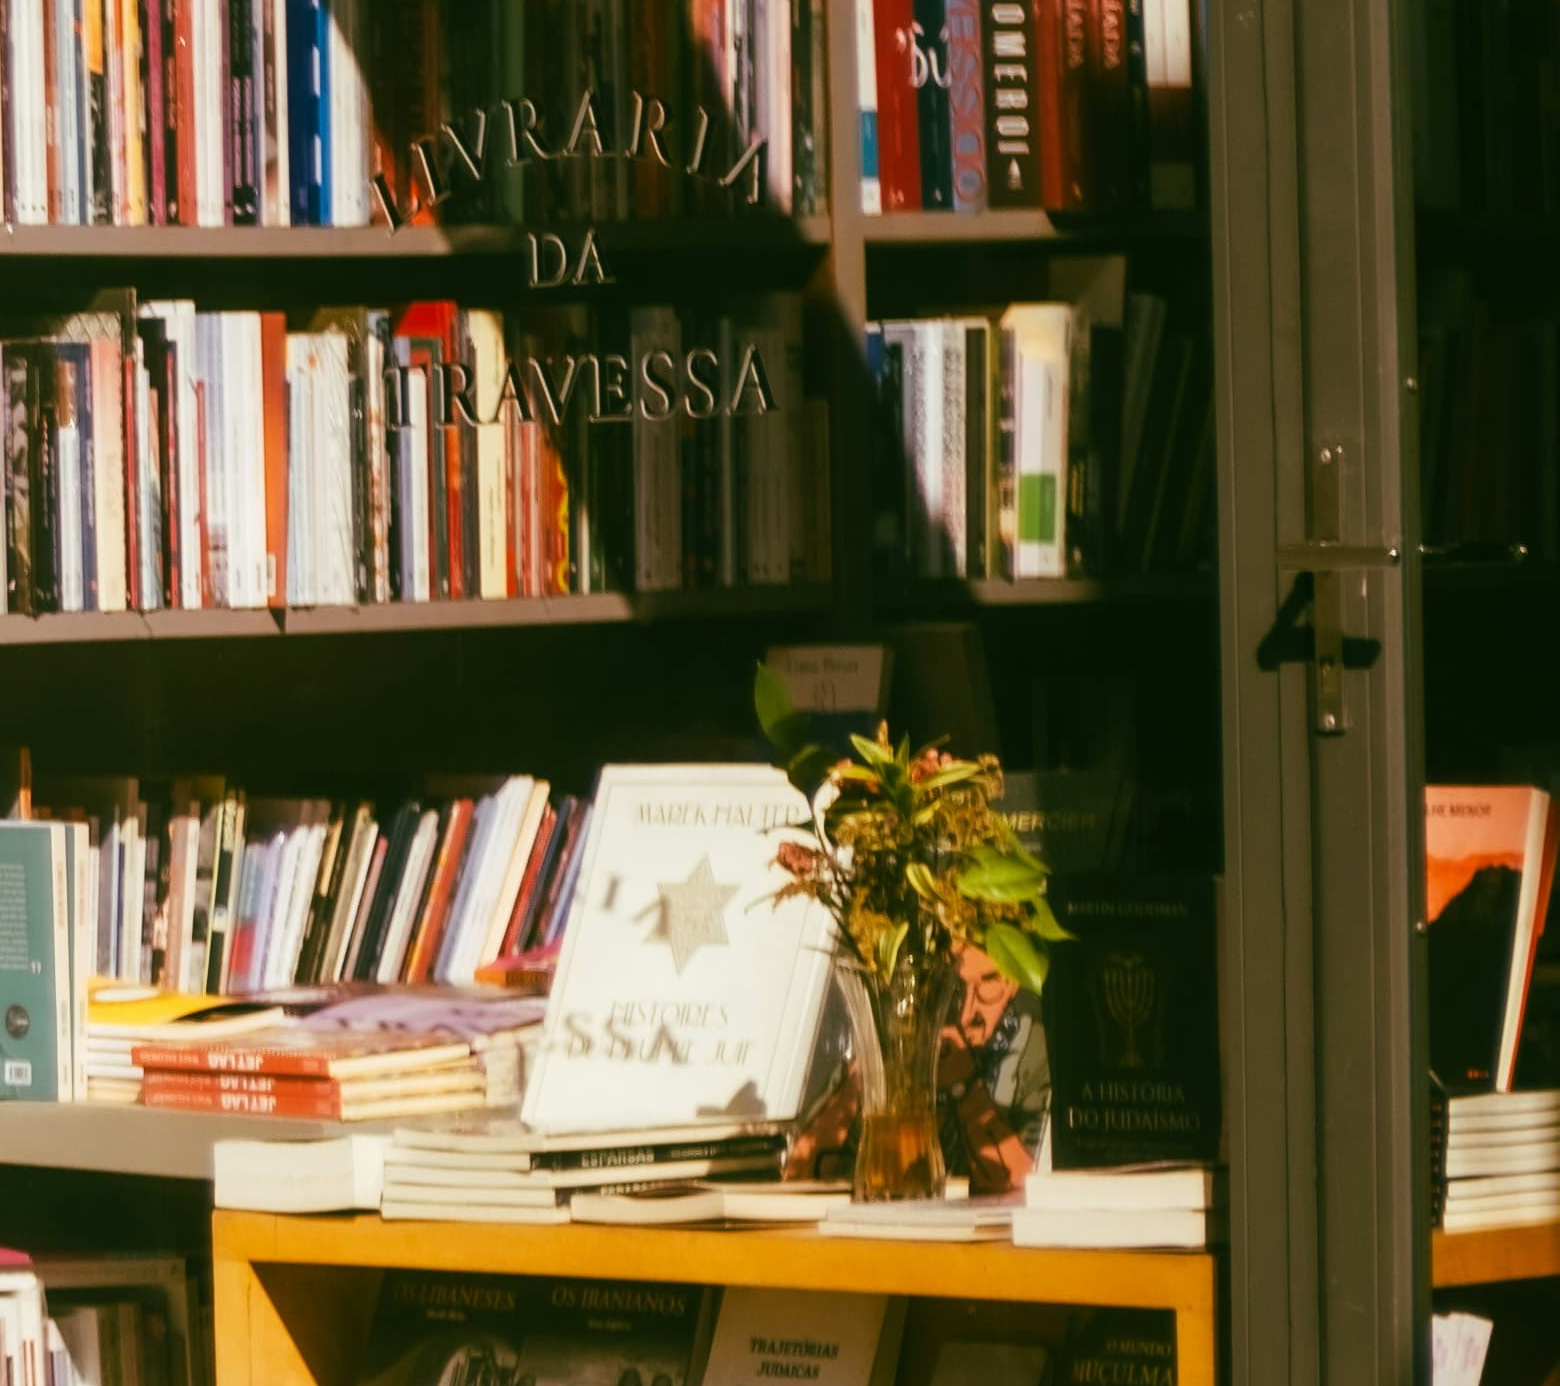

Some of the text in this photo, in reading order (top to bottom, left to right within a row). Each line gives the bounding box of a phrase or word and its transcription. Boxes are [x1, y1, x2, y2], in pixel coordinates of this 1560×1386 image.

[370, 88, 769, 234] LIVRARIA
[527, 227, 616, 289] DA
[383, 342, 779, 430] TRAVESSA
